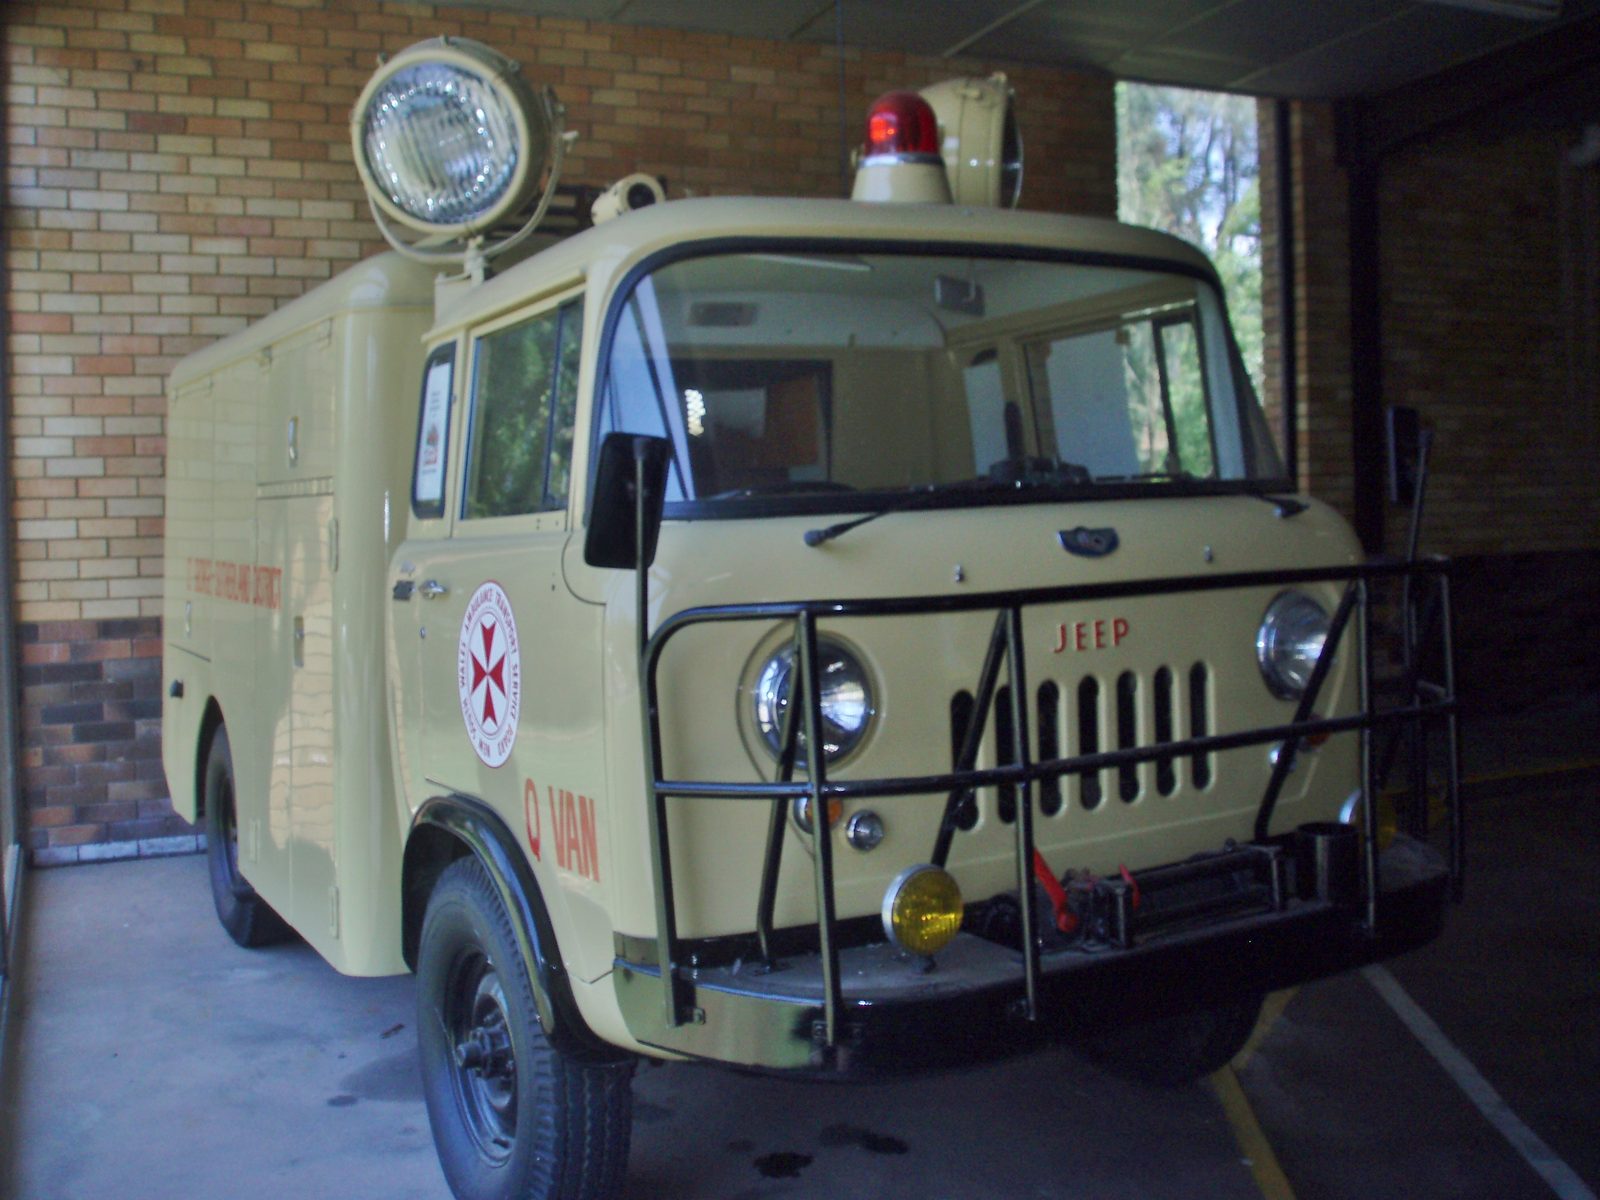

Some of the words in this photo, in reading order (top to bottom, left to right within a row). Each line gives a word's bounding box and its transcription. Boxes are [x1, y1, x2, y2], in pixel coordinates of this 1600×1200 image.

[1054, 617, 1129, 653] JEEP
[524, 778, 541, 862] Q
[547, 785, 600, 883] VAN
